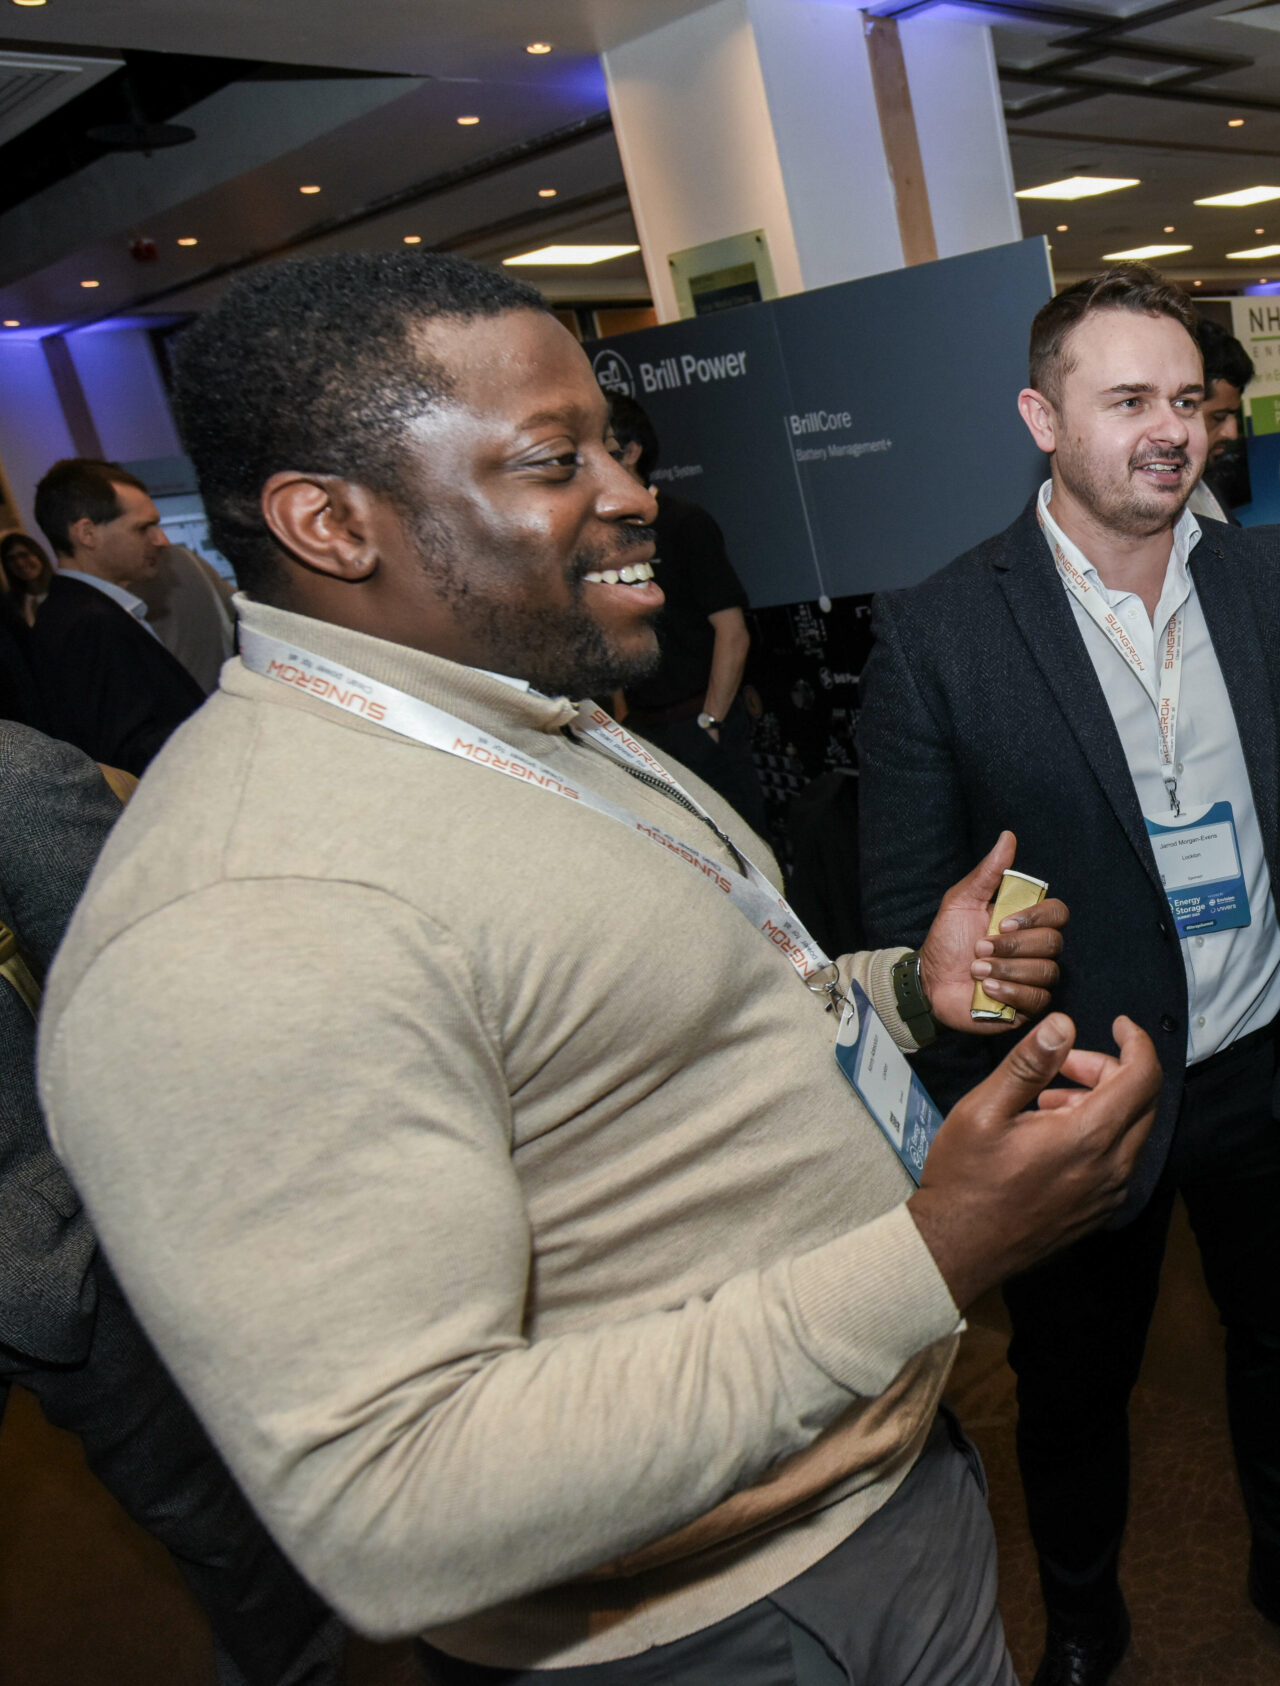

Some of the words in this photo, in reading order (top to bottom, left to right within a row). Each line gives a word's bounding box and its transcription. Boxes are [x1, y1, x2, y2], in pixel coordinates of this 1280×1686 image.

[640, 358, 682, 393] Brill
[680, 350, 747, 385] Power
[790, 410, 853, 436] BrillCore
[796, 447, 827, 463] Battery
[1104, 613, 1145, 671] SUNGROW
[266, 659, 388, 721] SUNGROW
[452, 737, 579, 800] SUNGROW
[589, 709, 676, 785] SUNGROW
[636, 823, 732, 894] SUNGROW
[1174, 896, 1201, 907] Energy
[1175, 904, 1206, 915] Storage
[761, 919, 816, 977] NGROW
